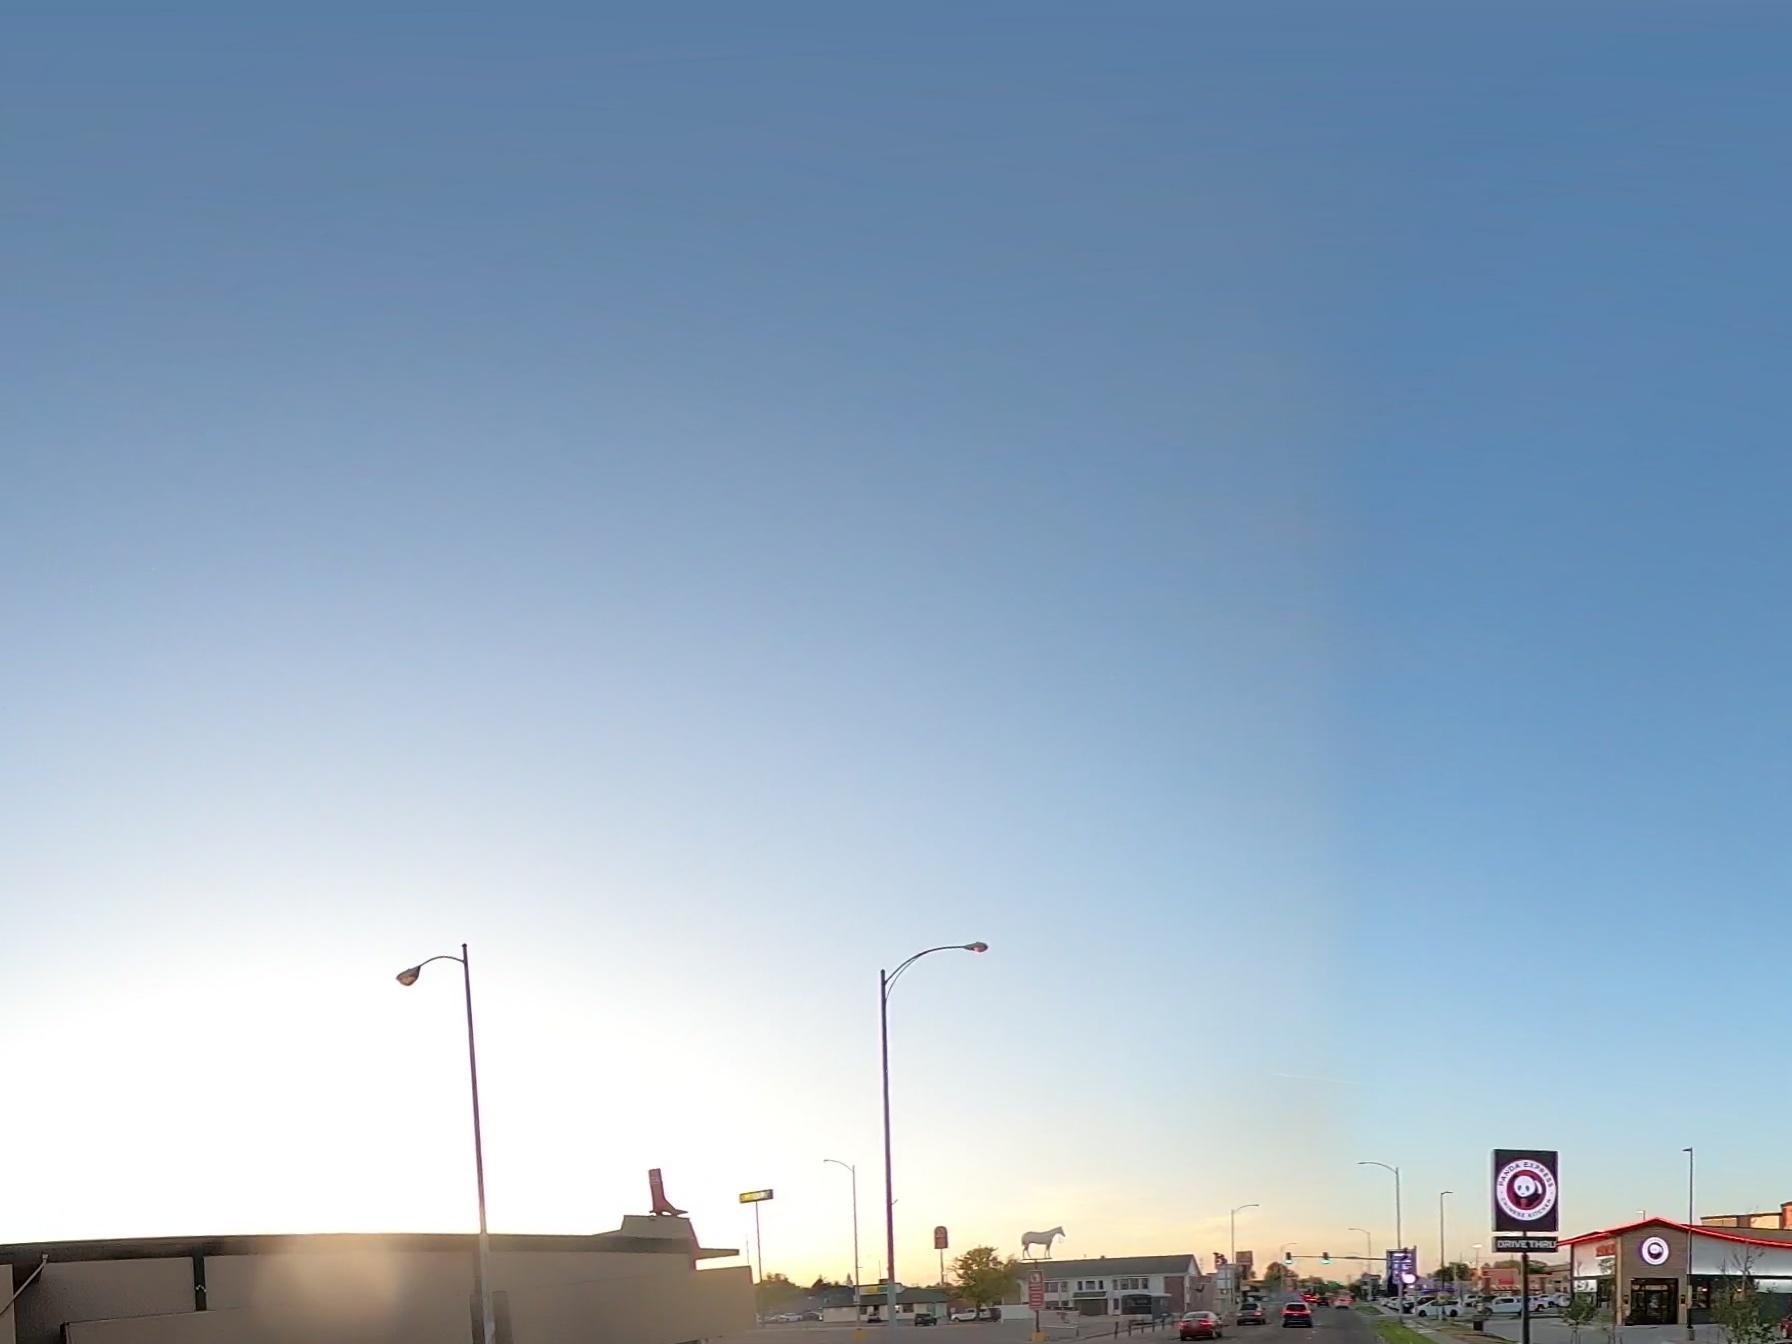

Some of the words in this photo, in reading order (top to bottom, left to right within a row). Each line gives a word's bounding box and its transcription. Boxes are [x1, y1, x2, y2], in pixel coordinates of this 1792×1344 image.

[1499, 1163, 1521, 1187] PANDA
[1497, 1240, 1528, 1249] DRIVE
[1529, 1240, 1557, 1249] THRU
